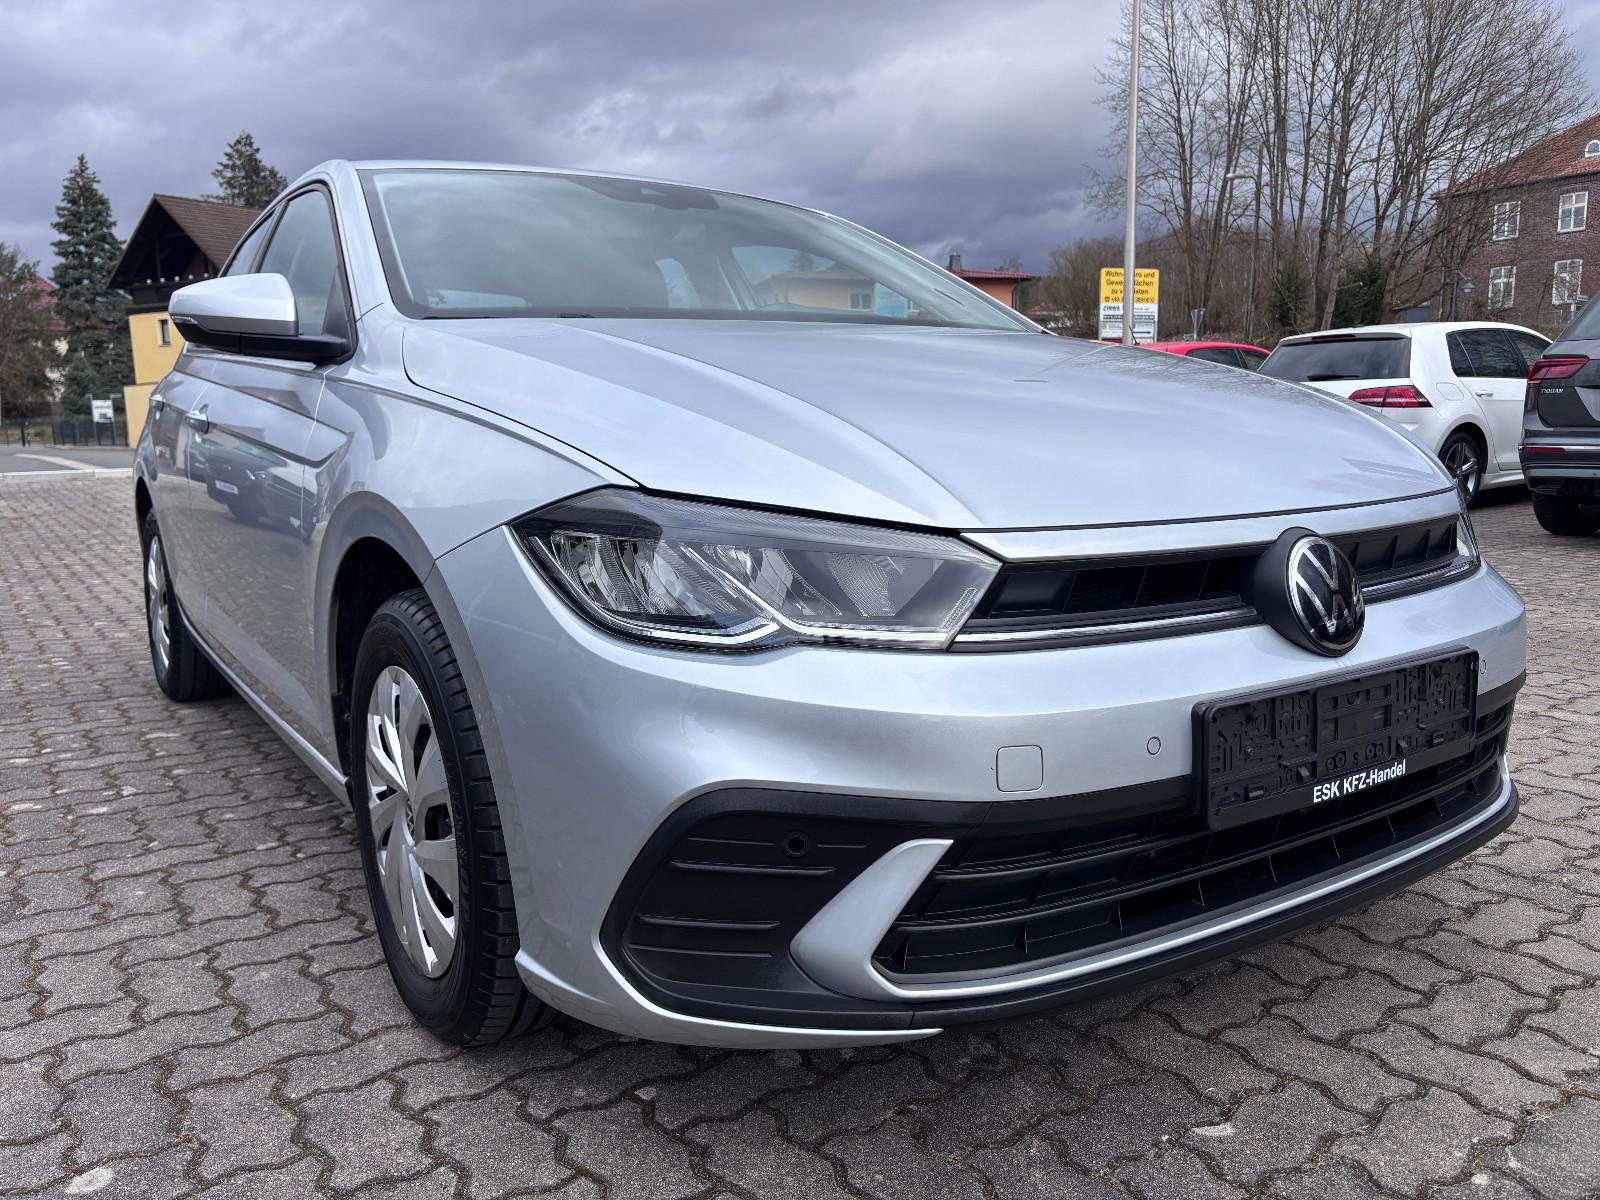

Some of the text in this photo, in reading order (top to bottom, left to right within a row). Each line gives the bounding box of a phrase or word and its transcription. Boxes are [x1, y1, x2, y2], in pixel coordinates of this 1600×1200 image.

[1143, 271, 1155, 279] und
[1313, 758, 1406, 803] ESK KFZ-Handel
